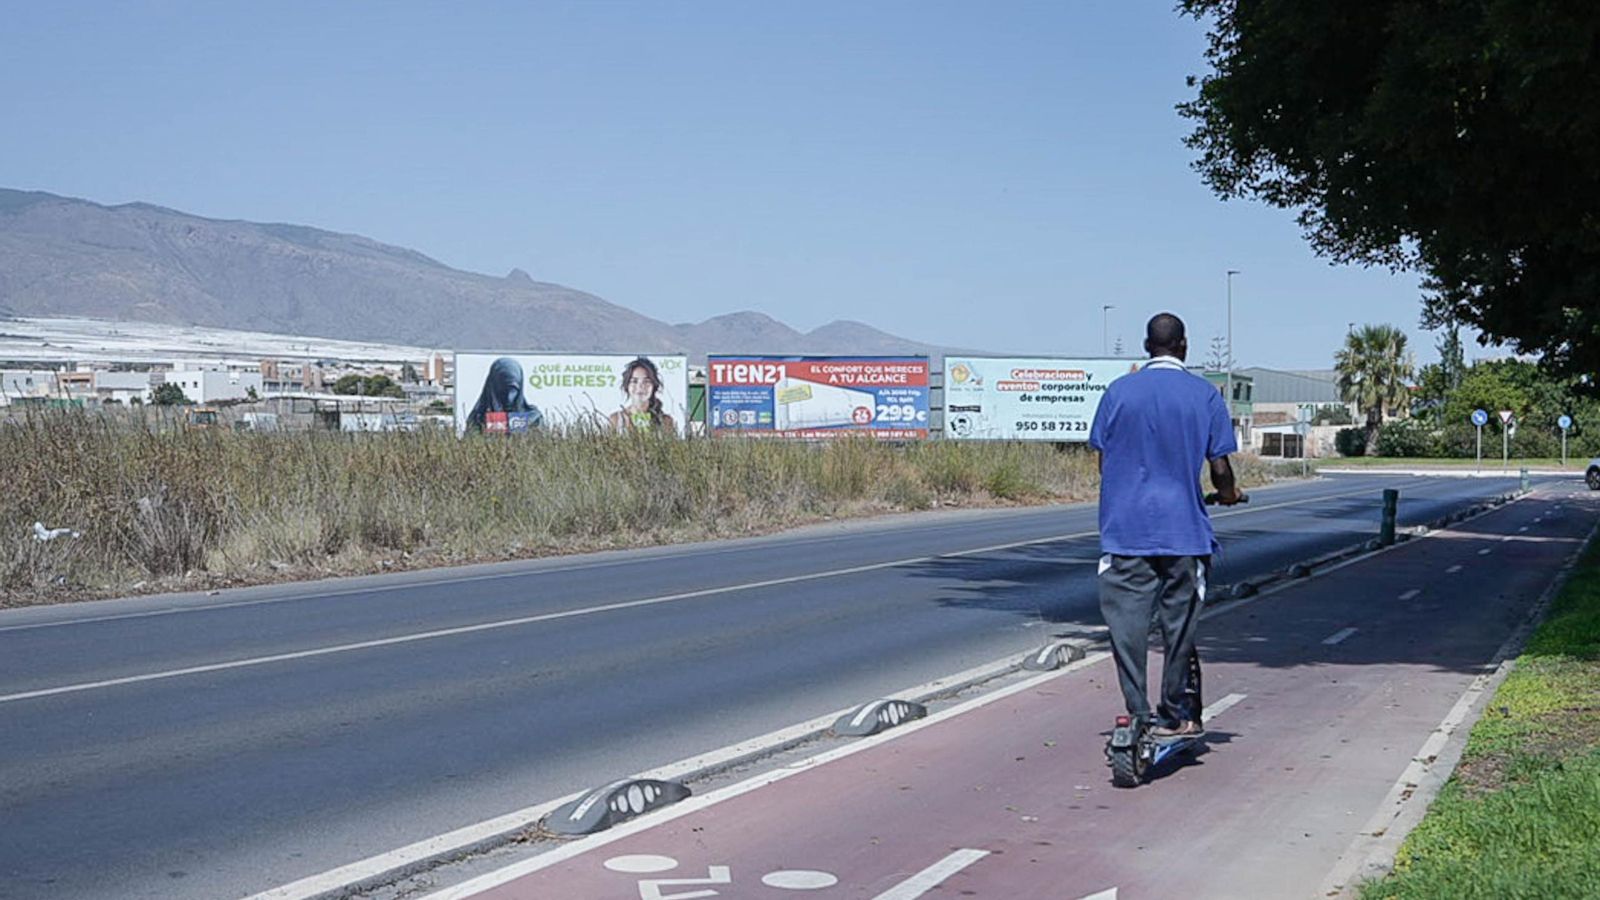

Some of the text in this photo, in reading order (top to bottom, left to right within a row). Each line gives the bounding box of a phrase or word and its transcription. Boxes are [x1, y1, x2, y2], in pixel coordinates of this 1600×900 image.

[532, 363, 612, 374] ¿QUÉ ALMERÍA
[660, 359, 682, 370] VOX
[864, 366, 882, 374] QUE
[1012, 370, 1084, 380] Celebraciones
[529, 375, 617, 389] QUIERES?
[828, 374, 907, 383] A TU ALCANCE
[998, 382, 1106, 392] eventos corporativos
[1020, 394, 1085, 404] de empresas
[1016, 421, 1088, 431] 950 58 72 23
